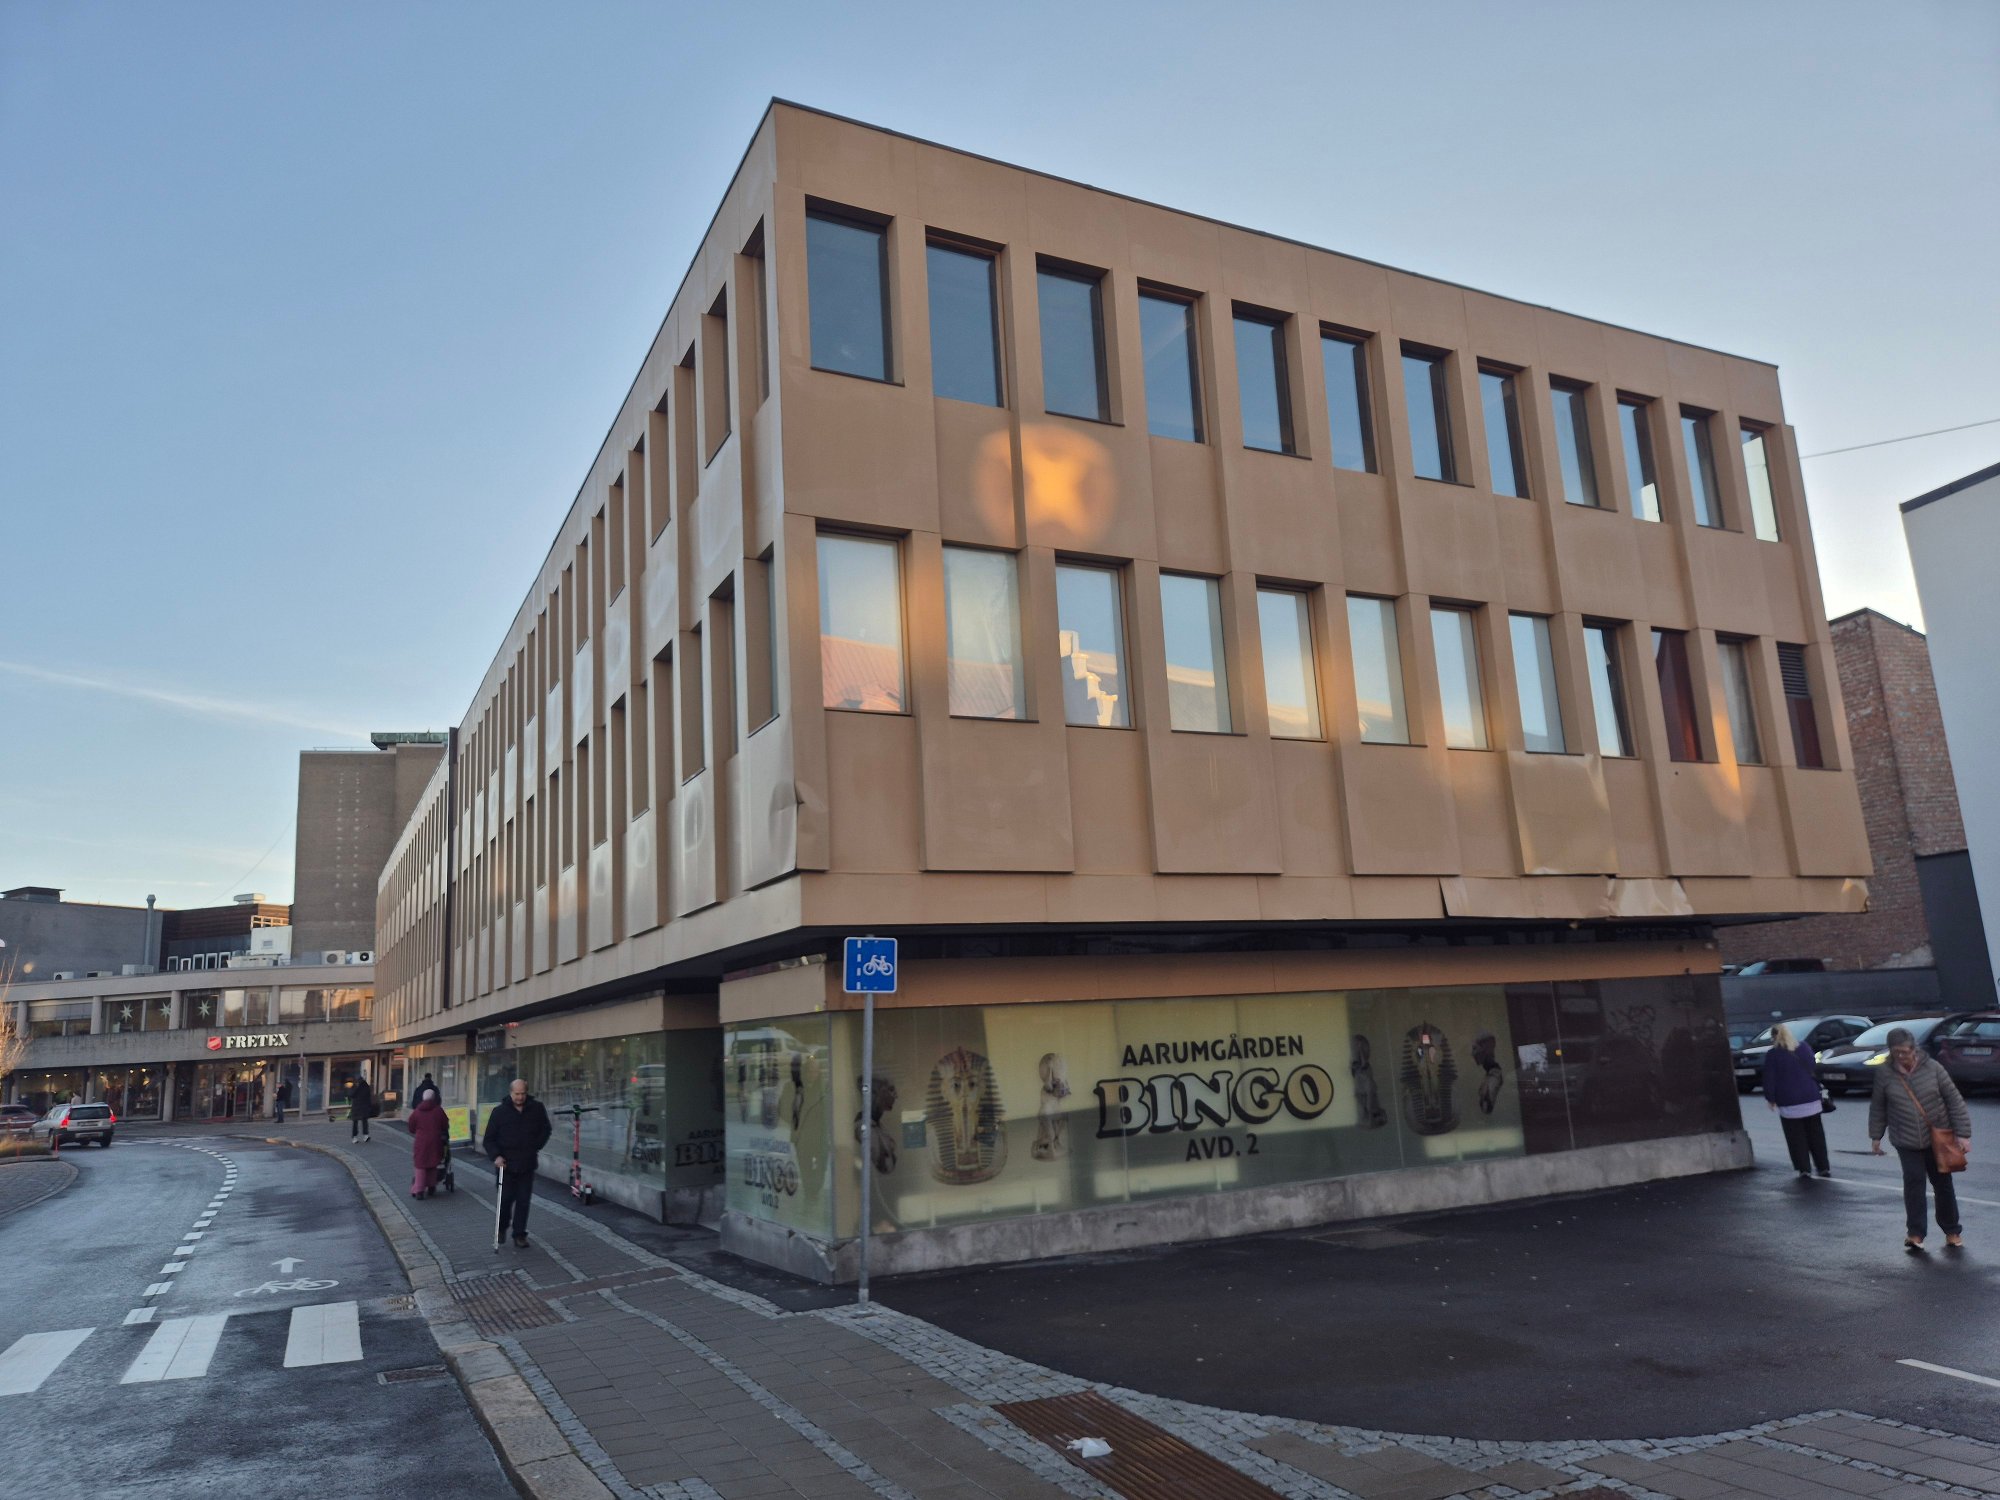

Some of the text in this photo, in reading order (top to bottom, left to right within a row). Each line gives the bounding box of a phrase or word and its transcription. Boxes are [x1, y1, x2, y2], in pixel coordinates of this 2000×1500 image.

[226, 1033, 289, 1049] FRETEX
[1122, 1034, 1303, 1066] AARUMGÅRDEN
[1094, 1064, 1334, 1138] BINGO
[1185, 1133, 1260, 1162] AVD. 2
[744, 1154, 798, 1196] BINGO
